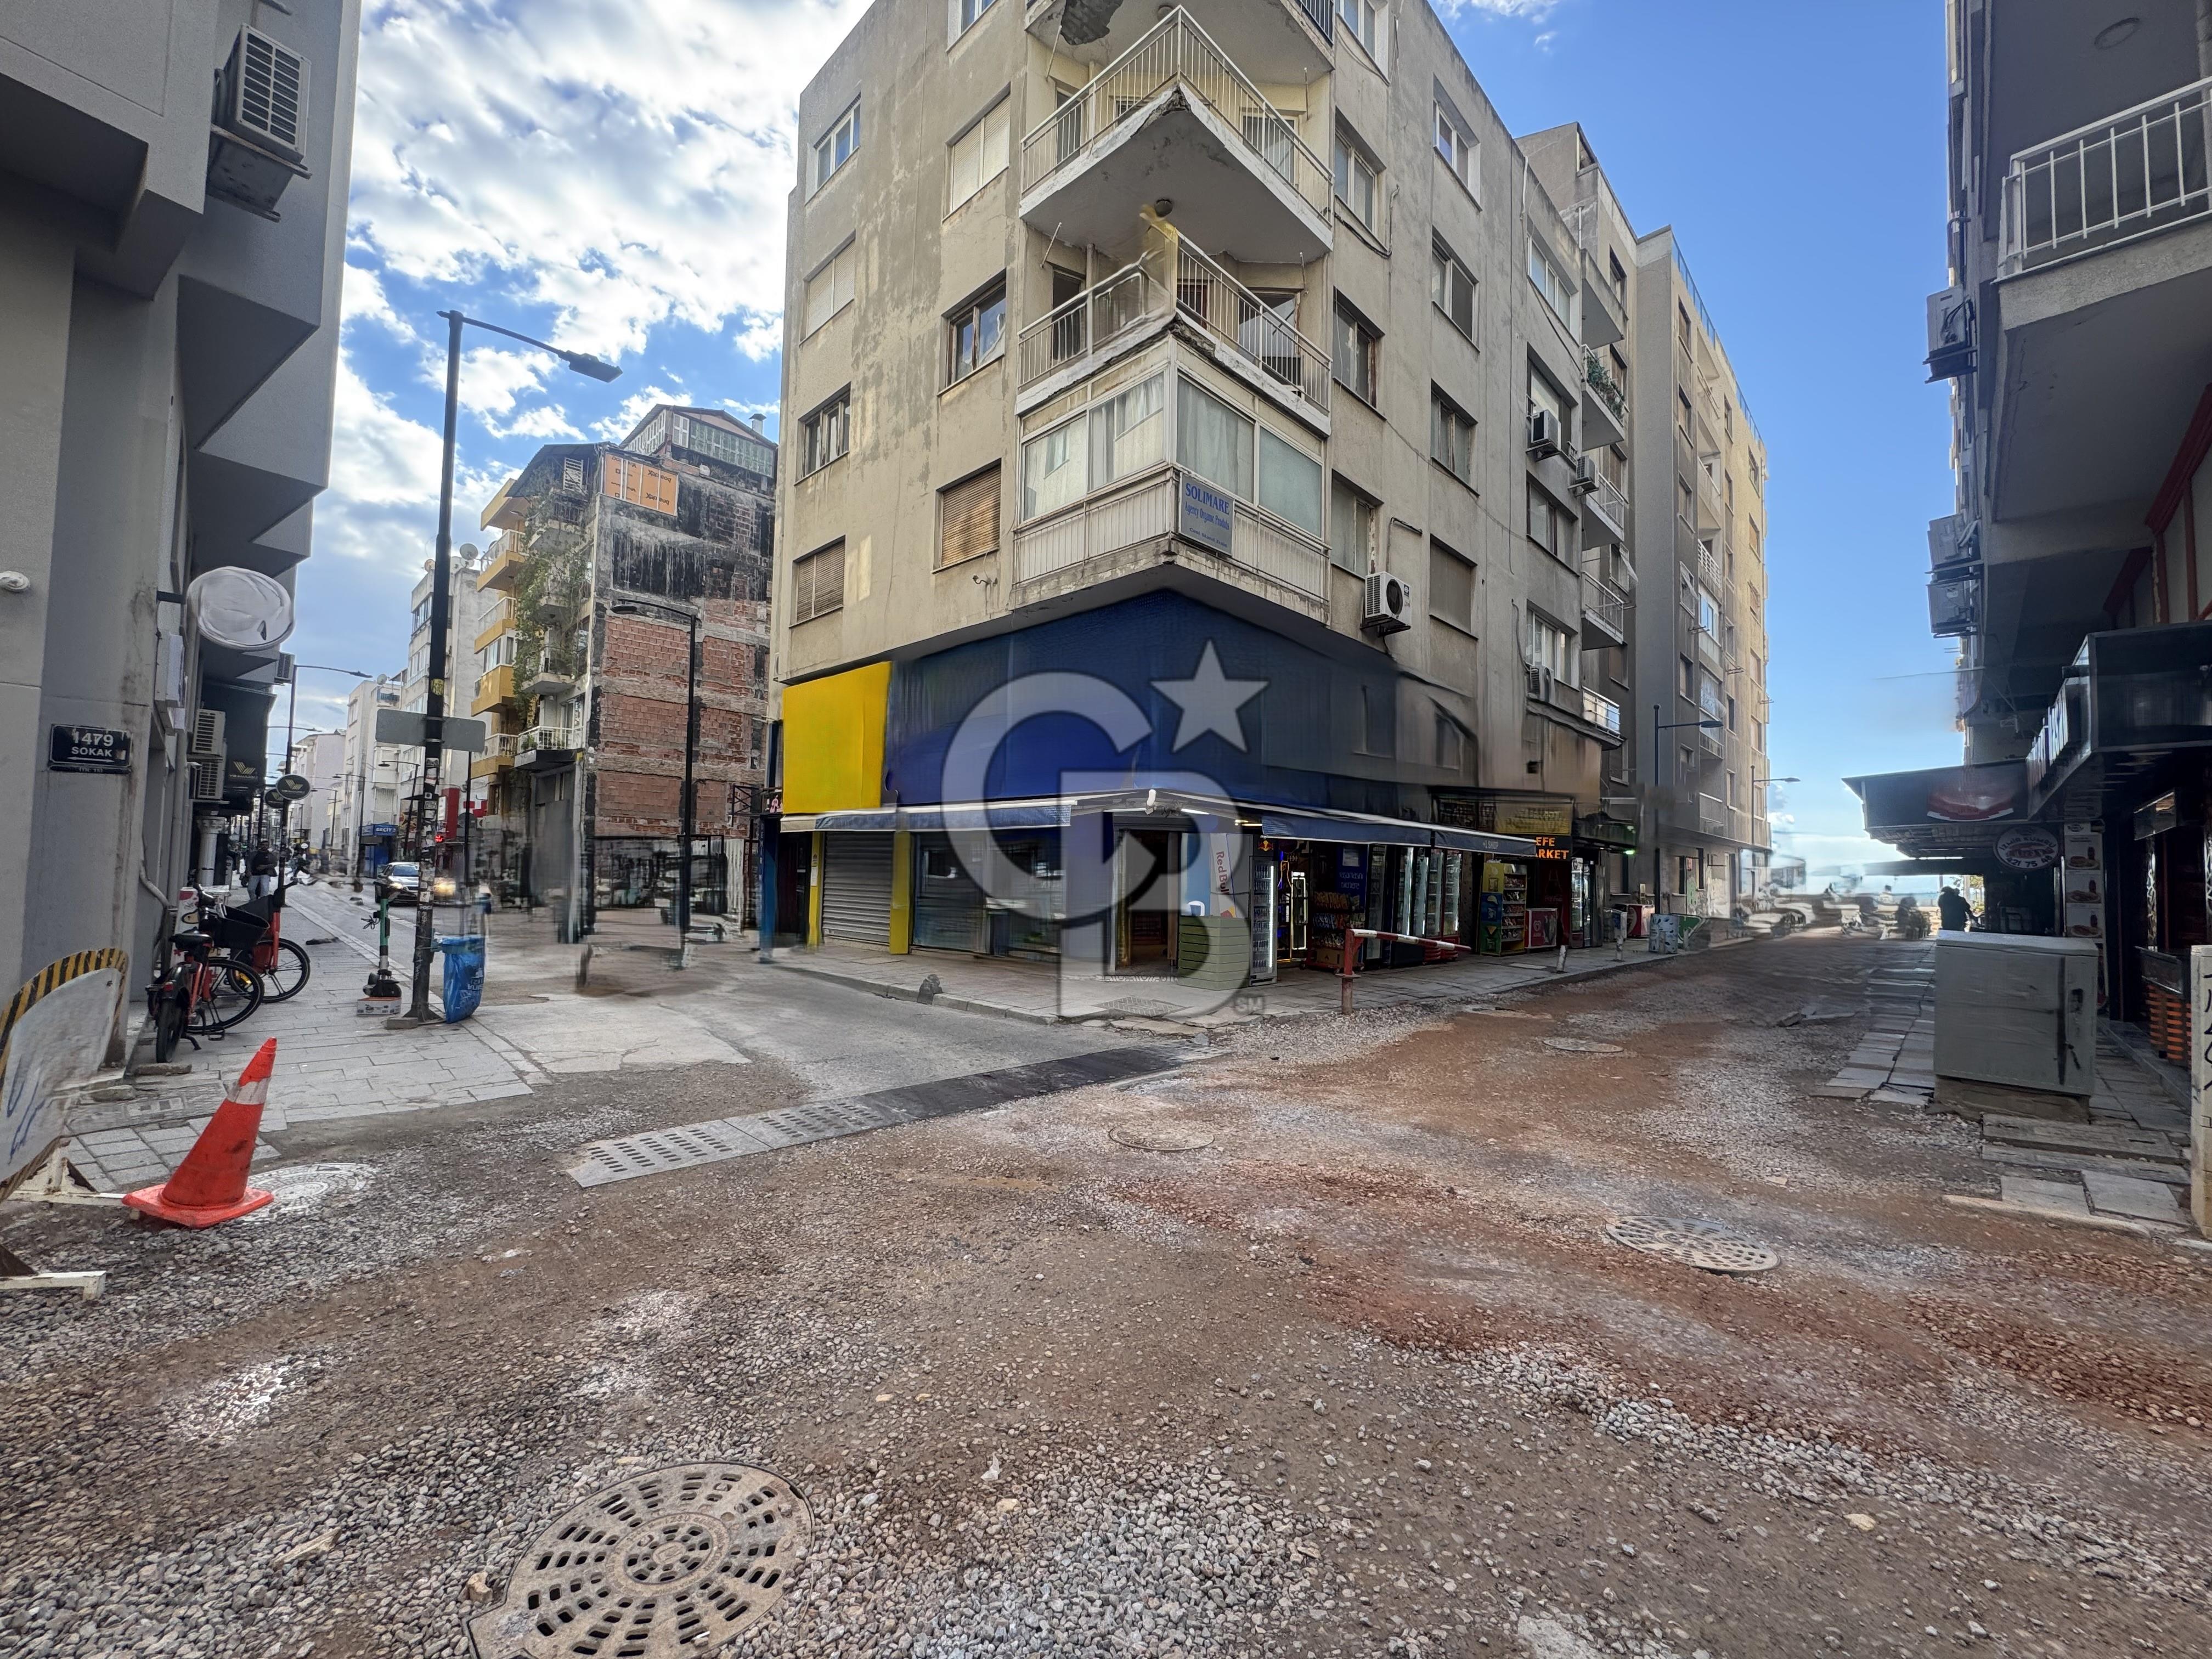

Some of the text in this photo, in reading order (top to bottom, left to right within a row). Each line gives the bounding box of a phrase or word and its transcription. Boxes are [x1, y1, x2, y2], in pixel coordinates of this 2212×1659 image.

[1185, 483, 1229, 515] SOLIMARE
[1185, 501, 1199, 518] Agency
[74, 731, 114, 747] 1479
[71, 747, 112, 757] SOKAK
[1536, 837, 1555, 847] EFE
[1216, 851, 1230, 895] Red Bull
